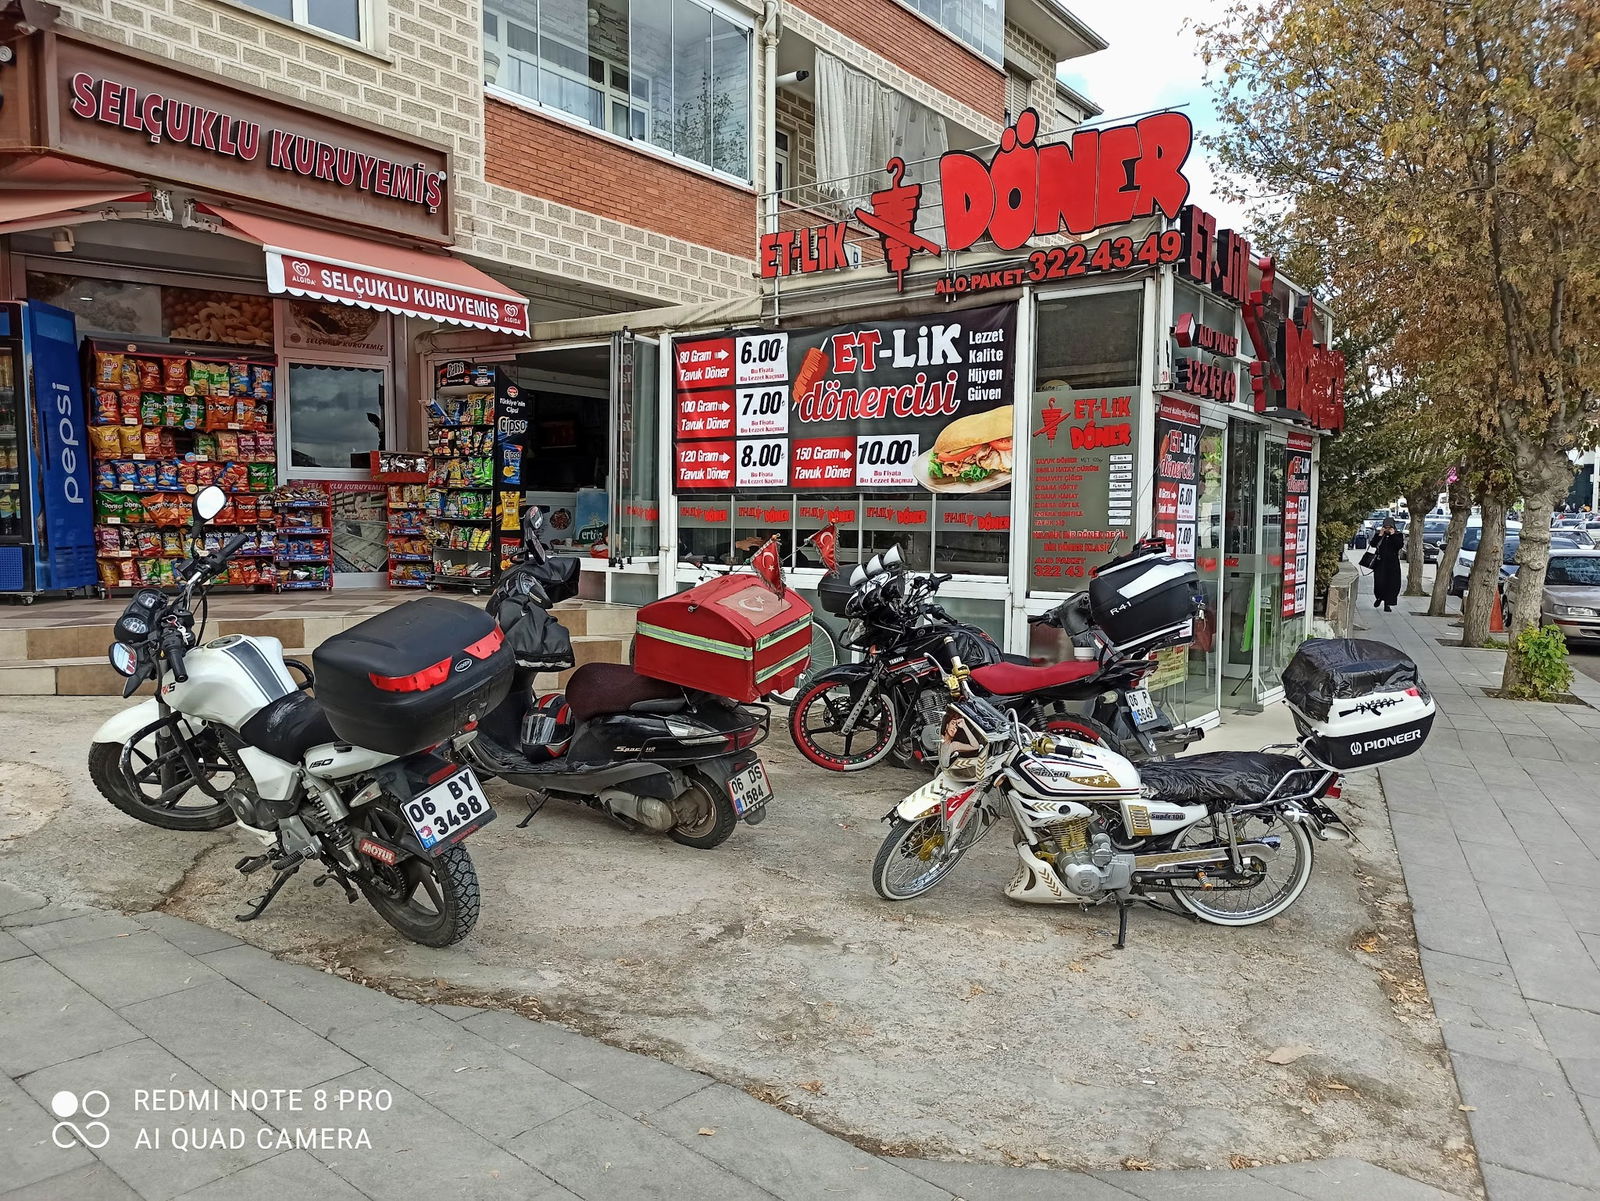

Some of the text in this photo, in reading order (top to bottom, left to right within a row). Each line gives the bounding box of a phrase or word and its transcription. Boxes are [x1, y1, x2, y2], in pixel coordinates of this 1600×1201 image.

[72, 72, 443, 214] SELÇUKLU KURUYEMİŞ
[939, 107, 1193, 251] DÖNER
[935, 229, 1184, 295] ALO PAKET 322 43 49
[292, 276, 316, 286] ALGIDA
[320, 268, 500, 325] SELÇUKLU KURUYEMİŞ
[969, 329, 1004, 345] Lezzet
[1215, 327, 1239, 357] PAKET
[680, 350, 712, 363] 80 Gram
[741, 339, 781, 365] 6.00
[968, 349, 1004, 364] Kalite
[680, 366, 730, 381] Tavuk Döner
[968, 369, 1003, 385] Hijyen
[741, 390, 782, 416] 7.00
[799, 370, 961, 424] dönercisi
[967, 387, 1001, 402] Güven
[681, 400, 718, 413] 100 Gram
[498, 416, 528, 437] Cipso
[681, 417, 730, 431] Tavuk Döner
[52, 382, 84, 504] pepsi
[1069, 420, 1132, 451] DÖNER
[681, 450, 719, 463] 120 Gram
[741, 443, 782, 467] 8.00
[795, 446, 839, 461] 150 Gram
[858, 439, 913, 465] 10.00
[680, 467, 730, 480] Tavuk Döner
[795, 465, 852, 479] Tavuk Döner
[306, 483, 342, 491] SELKLU
[1179, 488, 1193, 505] 6.00
[1177, 527, 1192, 545] 7.00
[1034, 565, 1062, 577] 322
[1065, 565, 1085, 577] 43
[1364, 729, 1421, 751] PIONEER
[731, 766, 763, 795] 06 DS
[408, 772, 473, 823] 06 BY
[742, 784, 764, 808] 1584
[433, 795, 482, 835] 3498
[362, 842, 394, 863] MOTUL
[424, 837, 437, 847] TR
